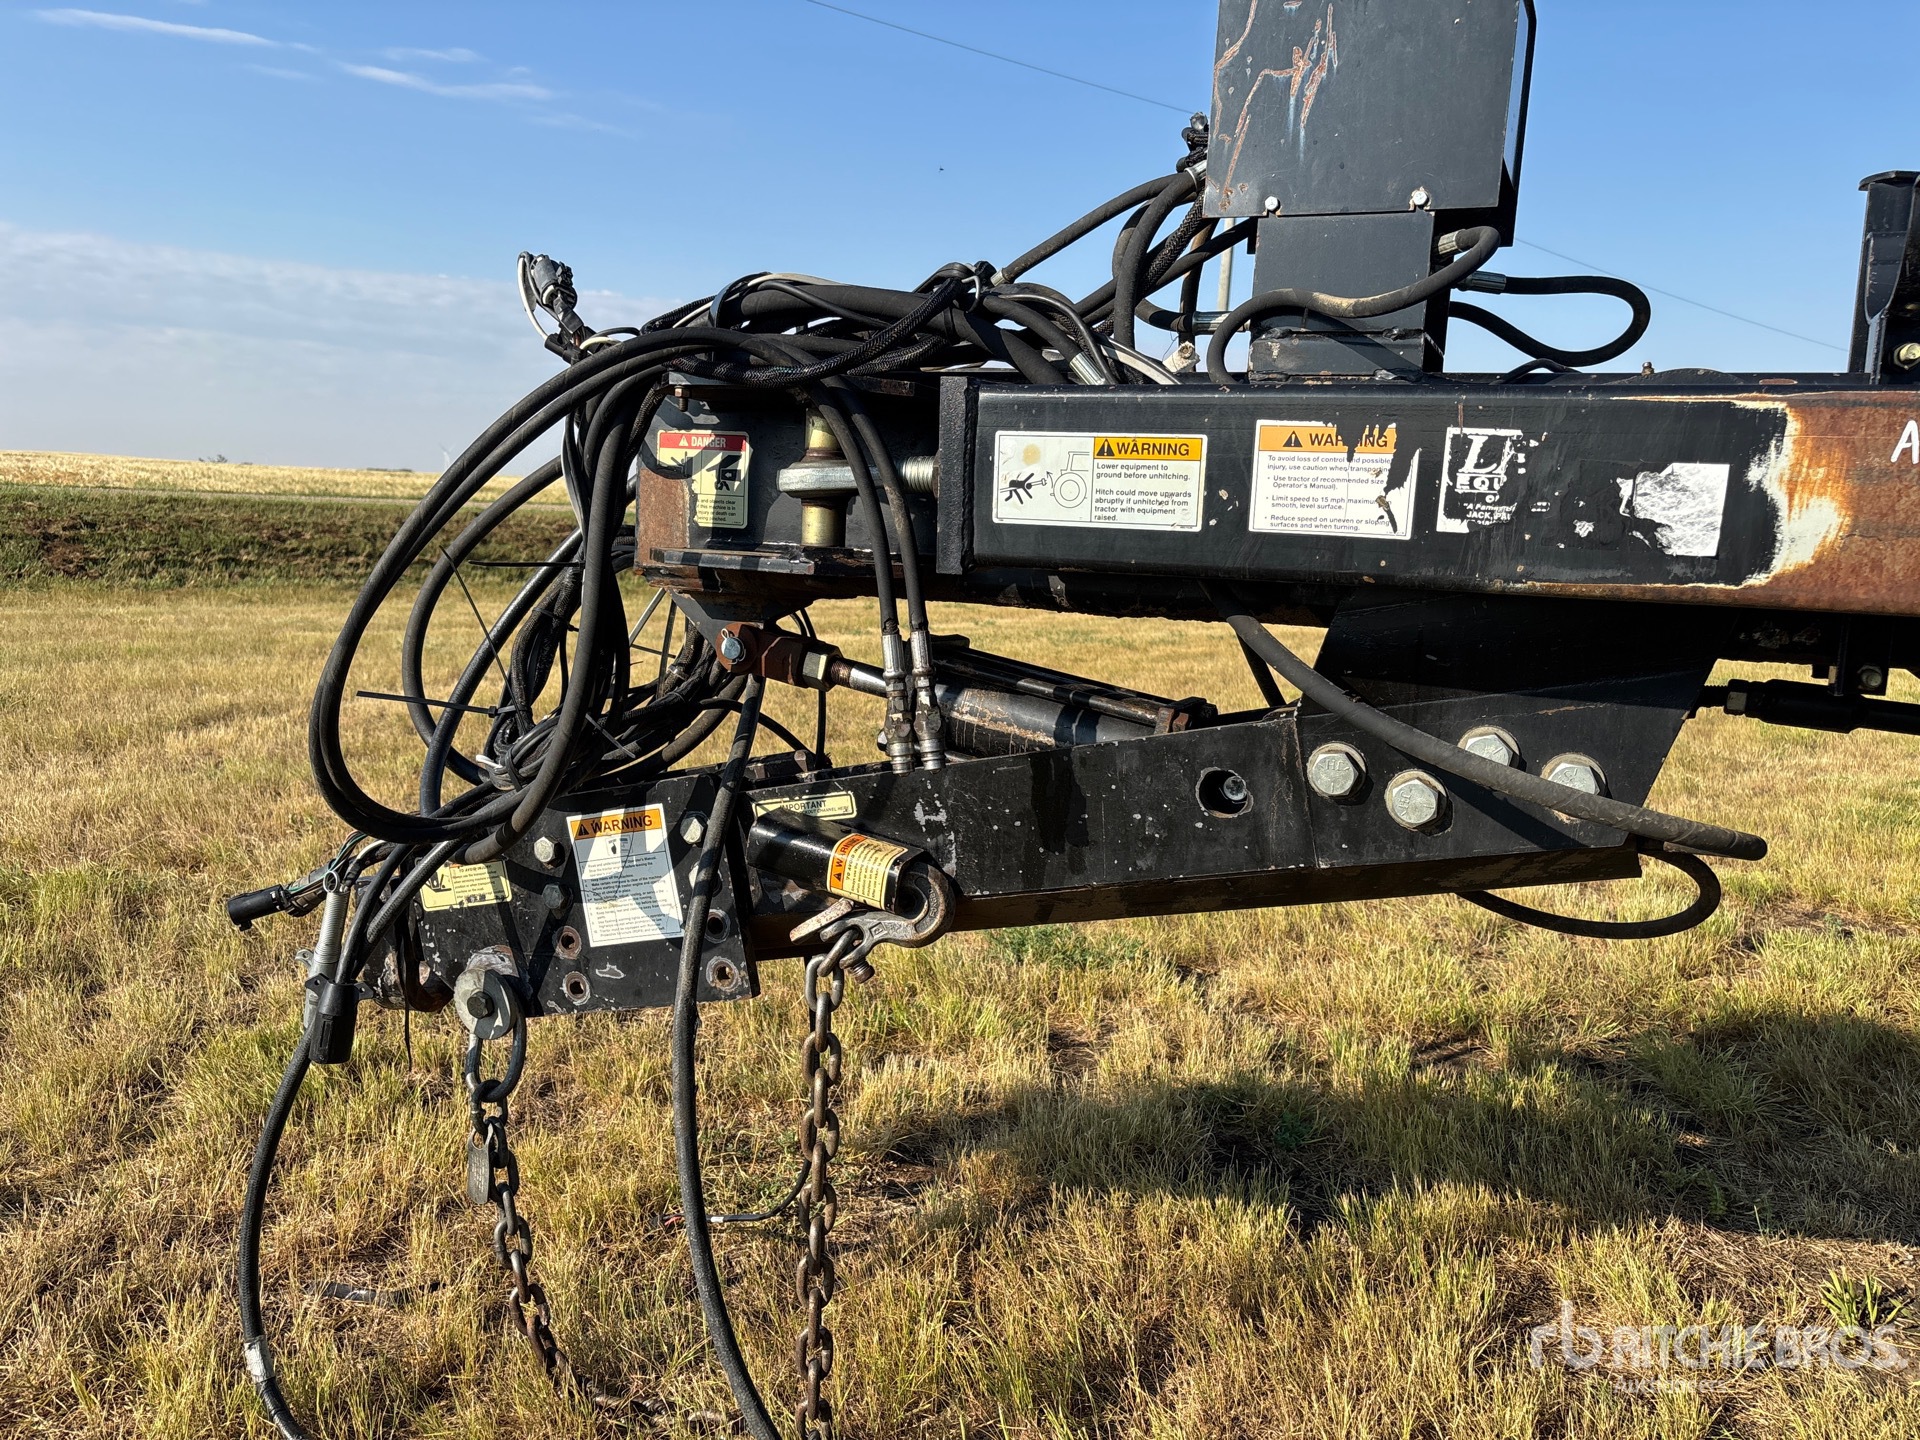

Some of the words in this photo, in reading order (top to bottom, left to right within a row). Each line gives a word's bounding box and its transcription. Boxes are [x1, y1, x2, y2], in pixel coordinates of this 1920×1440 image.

[691, 436, 726, 447] DANGER
[1117, 442, 1190, 456] WARNING
[1120, 464, 1159, 472] equipment
[1096, 472, 1122, 480] ground
[1149, 473, 1191, 481] unhitching.
[1095, 488, 1114, 496] Hitch
[1116, 489, 1136, 497] could
[1160, 490, 1192, 498] upwards
[1095, 497, 1124, 506] abruptly
[1133, 498, 1169, 506] unhitched
[1466, 511, 1493, 521] JACK,
[1365, 518, 1390, 526] sloping
[591, 815, 653, 833] WARNING
